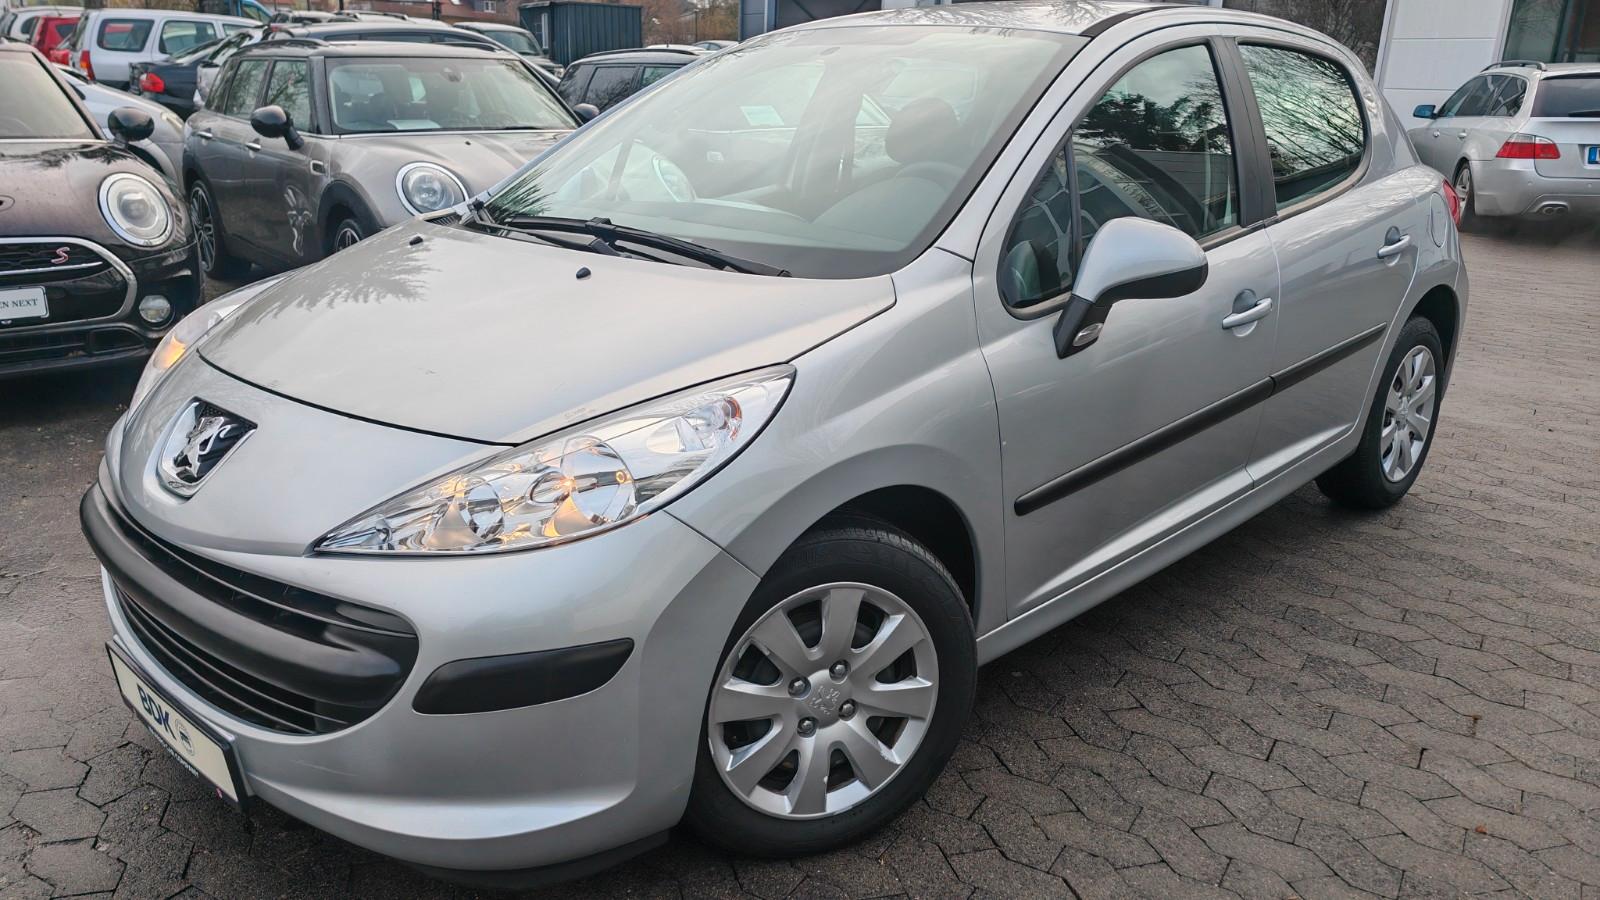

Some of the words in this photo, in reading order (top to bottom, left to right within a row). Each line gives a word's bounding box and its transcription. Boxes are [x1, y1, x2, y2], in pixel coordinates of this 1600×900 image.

[51, 246, 70, 264] S
[12, 298, 38, 308] NEXT
[136, 683, 178, 741] BDK
